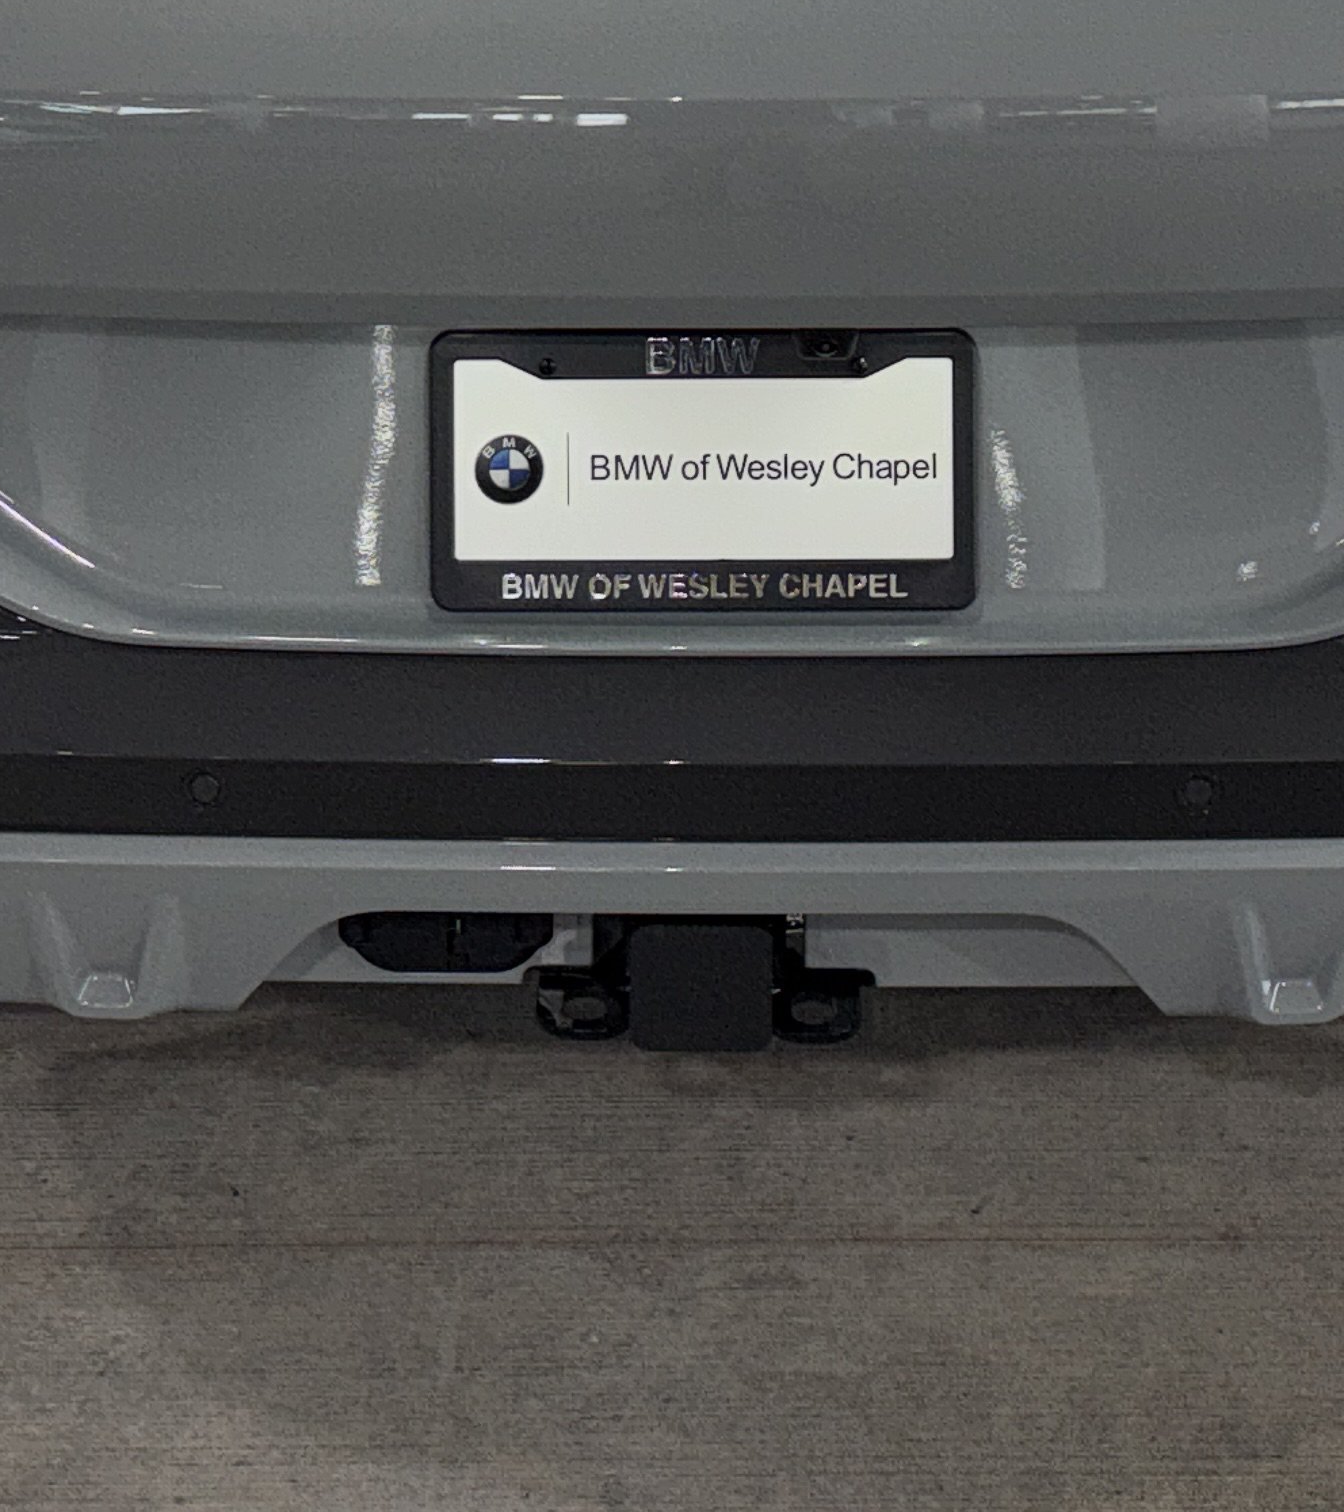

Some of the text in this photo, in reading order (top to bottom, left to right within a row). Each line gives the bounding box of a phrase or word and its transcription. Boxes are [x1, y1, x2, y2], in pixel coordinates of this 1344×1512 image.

[645, 336, 760, 376] BMW
[482, 437, 537, 459] BMW
[590, 452, 937, 487] BMW of Wesley Chapel
[501, 572, 909, 600] BMW OF WESLEY CHAPEL
